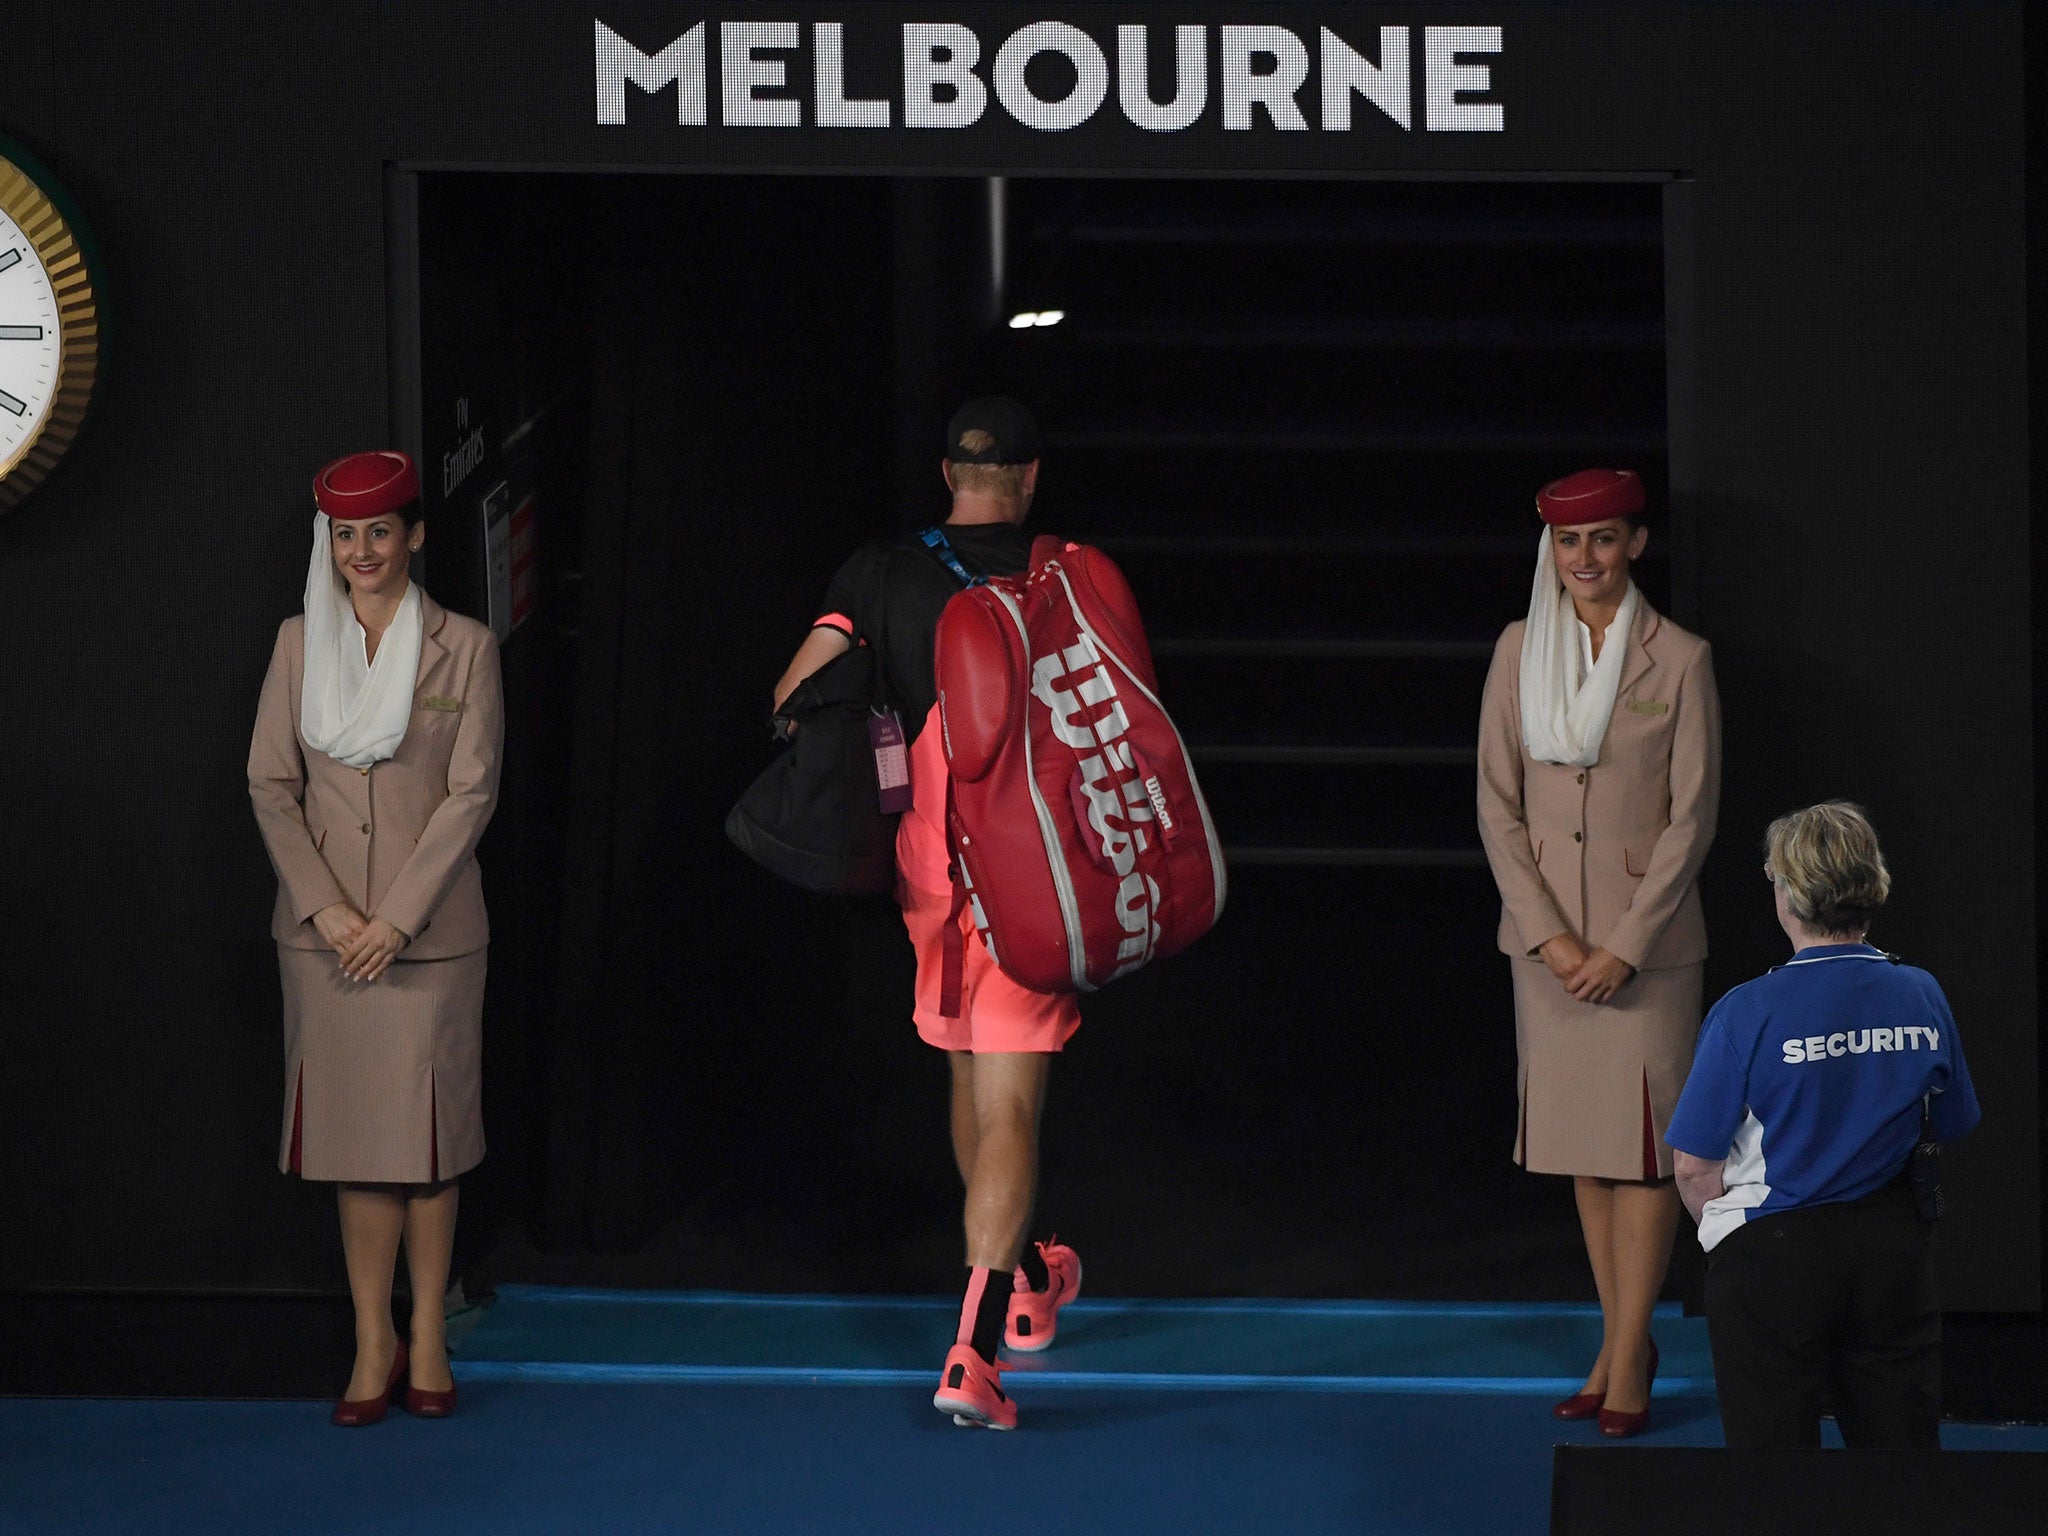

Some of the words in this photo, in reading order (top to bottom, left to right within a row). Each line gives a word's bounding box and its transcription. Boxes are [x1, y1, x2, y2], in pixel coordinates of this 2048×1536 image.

[595, 18, 1506, 133] MELBOURNE
[443, 424, 485, 498] Emirates
[1030, 632, 1161, 981] Wilson
[1145, 776, 1173, 832] Wilson
[1782, 1026, 1940, 1064] SECURITY
